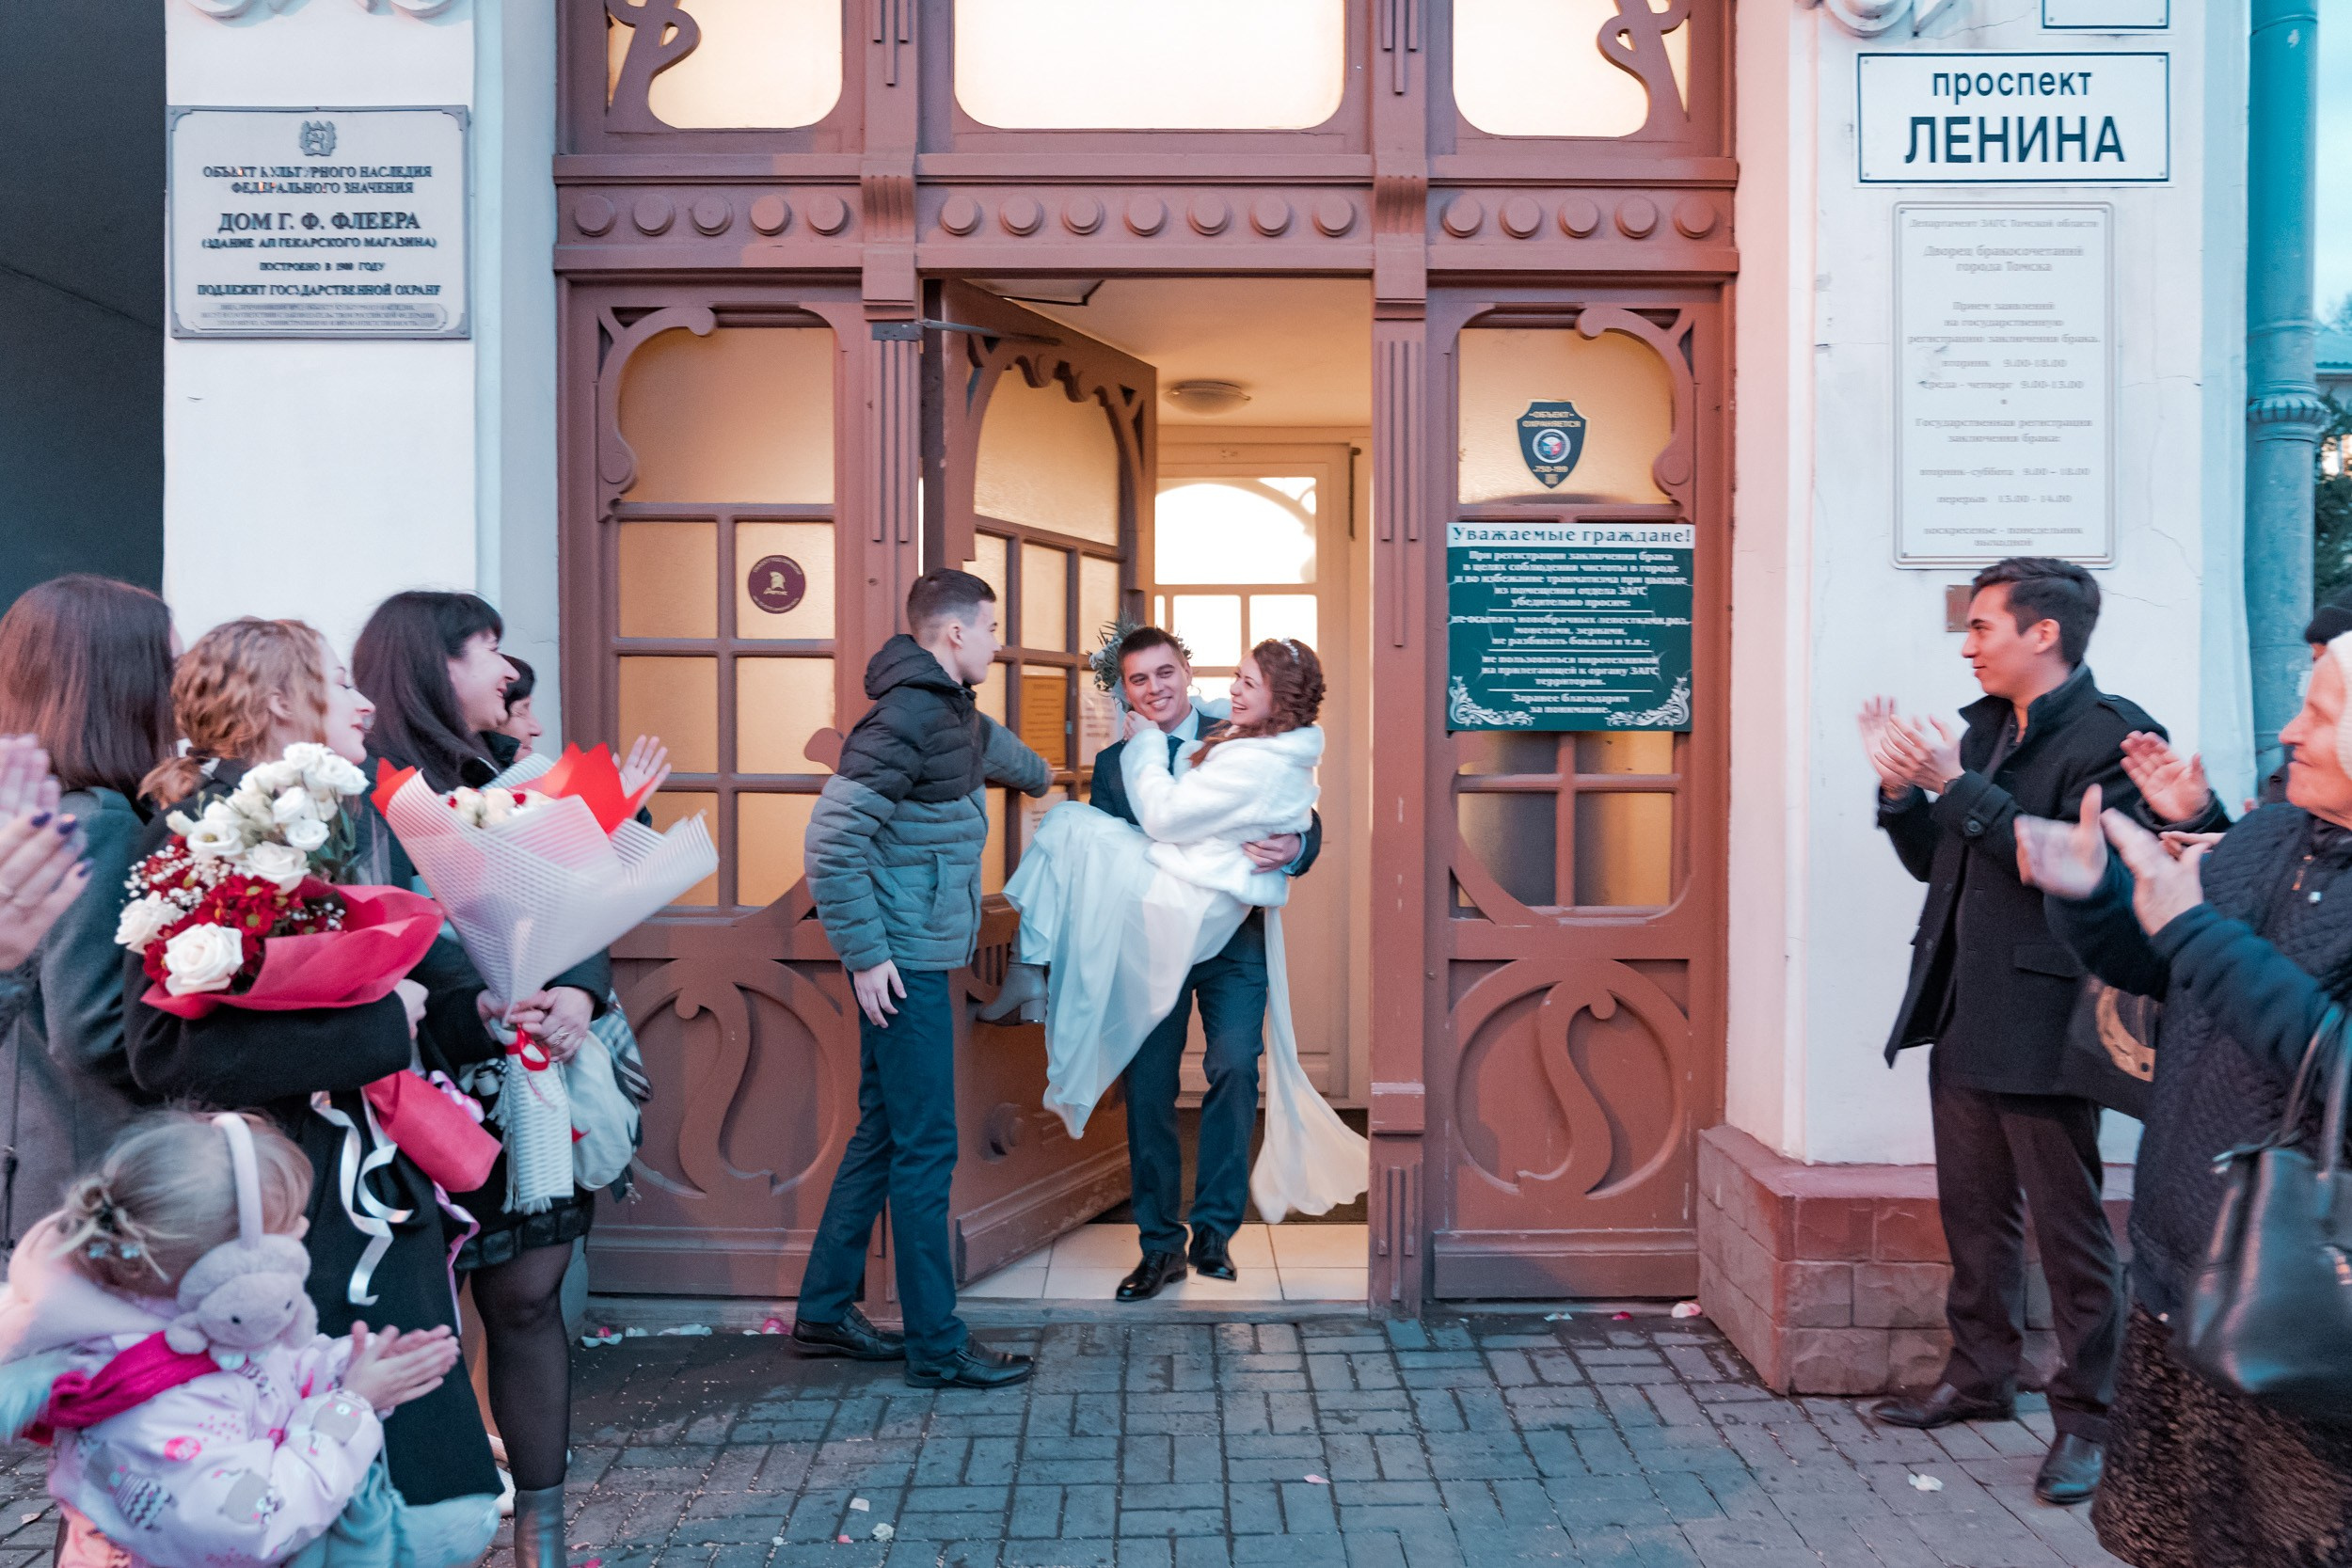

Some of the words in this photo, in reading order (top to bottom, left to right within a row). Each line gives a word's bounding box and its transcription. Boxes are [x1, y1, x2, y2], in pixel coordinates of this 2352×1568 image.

[1933, 72, 2092, 105] проспект
[1904, 116, 2125, 164] ЛЕНИНА
[359, 166, 433, 179] НАСЛЕДИЯ
[343, 182, 414, 194] ЗНАЧЕНИЯ
[217, 213, 273, 233] ДОМ
[278, 213, 294, 230] Г.
[300, 212, 325, 230] Ф.
[330, 212, 421, 230] ФЛЕЕРА
[201, 238, 255, 249] (ЗДАНИЕ
[258, 237, 361, 248] АПТЕКАРСКОГО
[363, 236, 437, 248] МАГАЗИНА)
[259, 262, 322, 271] ПОСТРОЕНО
[325, 262, 332, 271] В
[358, 262, 385, 272] ГОДУ
[197, 285, 267, 296] ПОДЛЕЖИТ
[269, 283, 392, 296] ГОСУДАРСТВЕННОЙ
[1453, 527, 1577, 542] Уважаемые
[1582, 529, 1691, 545] граждане!
[1618, 587, 1648, 595] ЗАГС
[1629, 667, 1659, 675] ЗАГС
